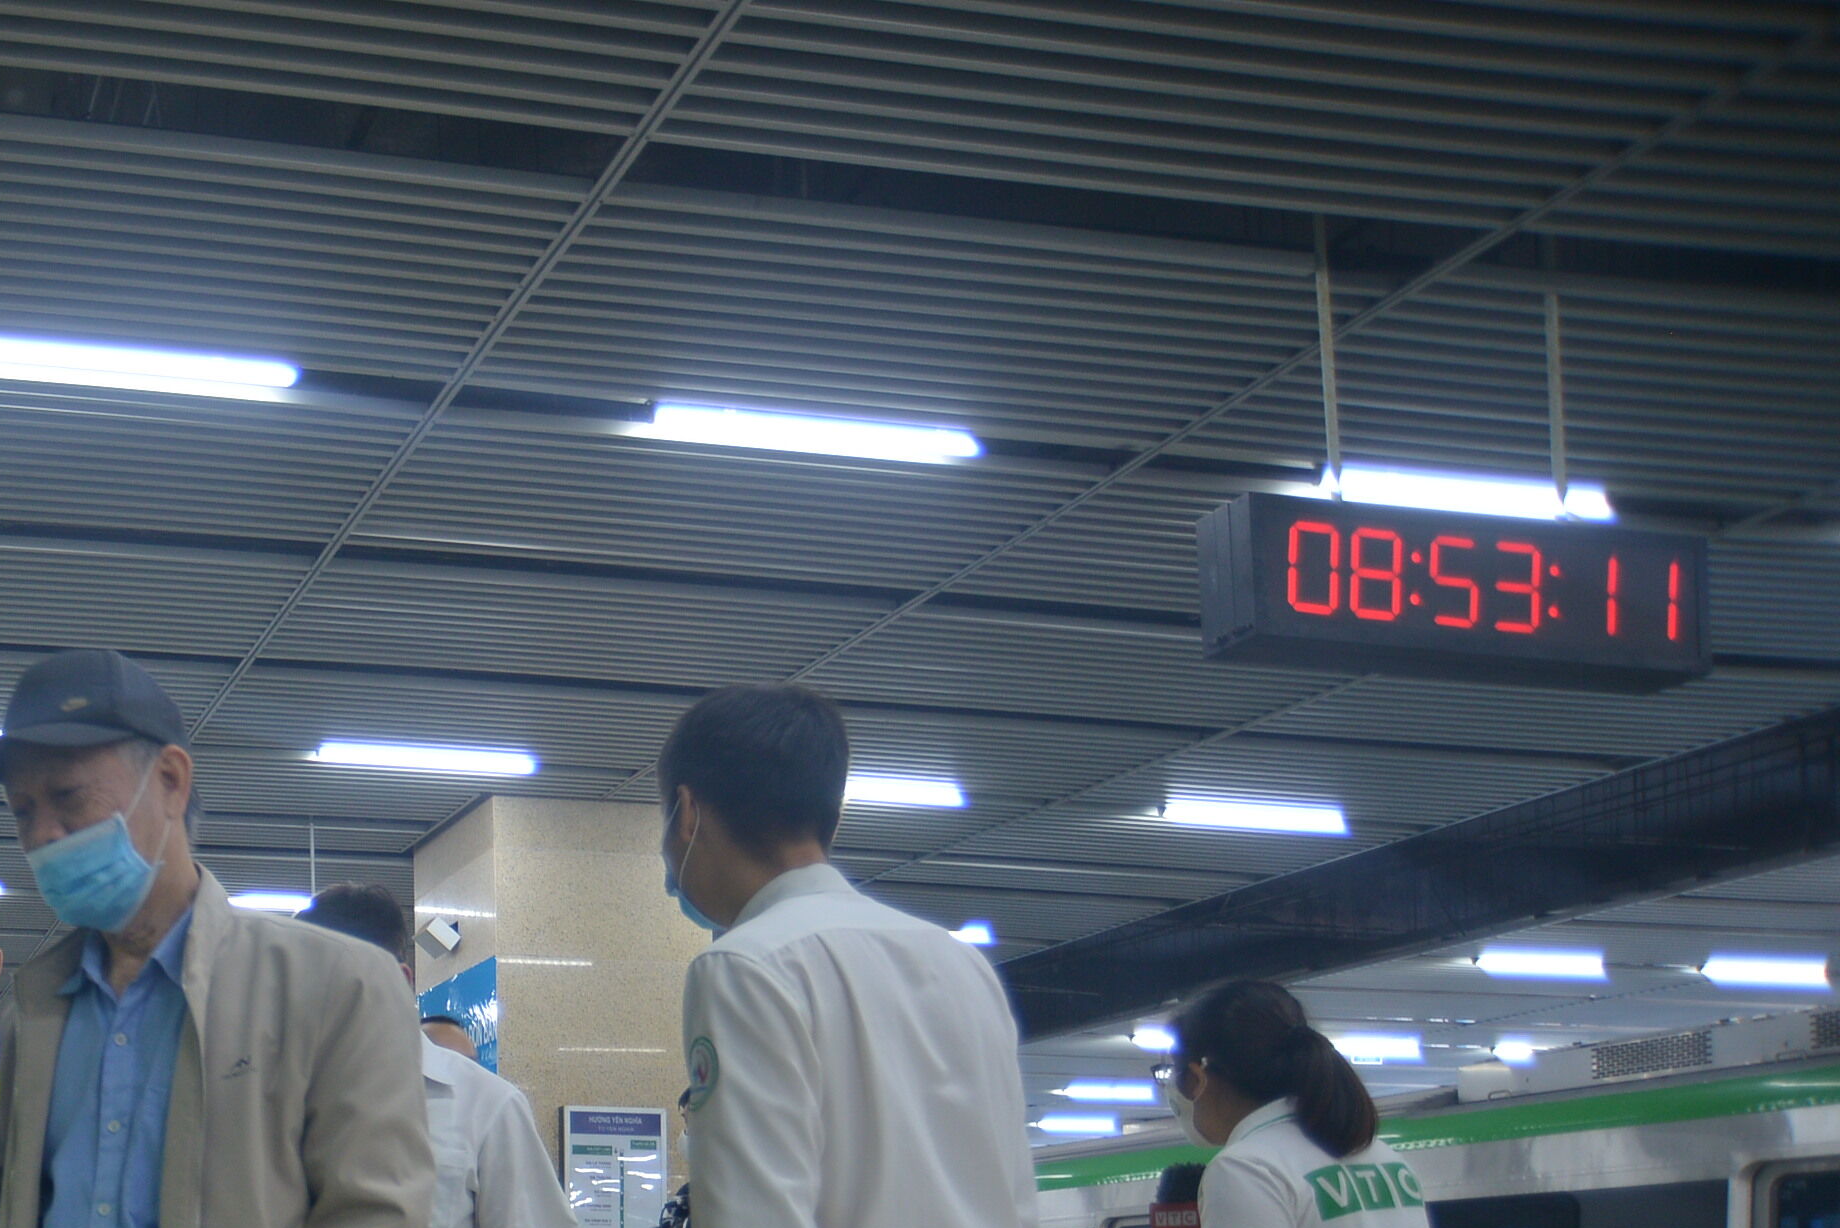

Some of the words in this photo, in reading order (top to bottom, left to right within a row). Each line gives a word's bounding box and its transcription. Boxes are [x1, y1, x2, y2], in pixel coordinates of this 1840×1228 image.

[1287, 520, 1679, 641] 08:53:11
[1313, 1165, 1424, 1210] VTC
[1155, 1211, 1197, 1227] VTC
